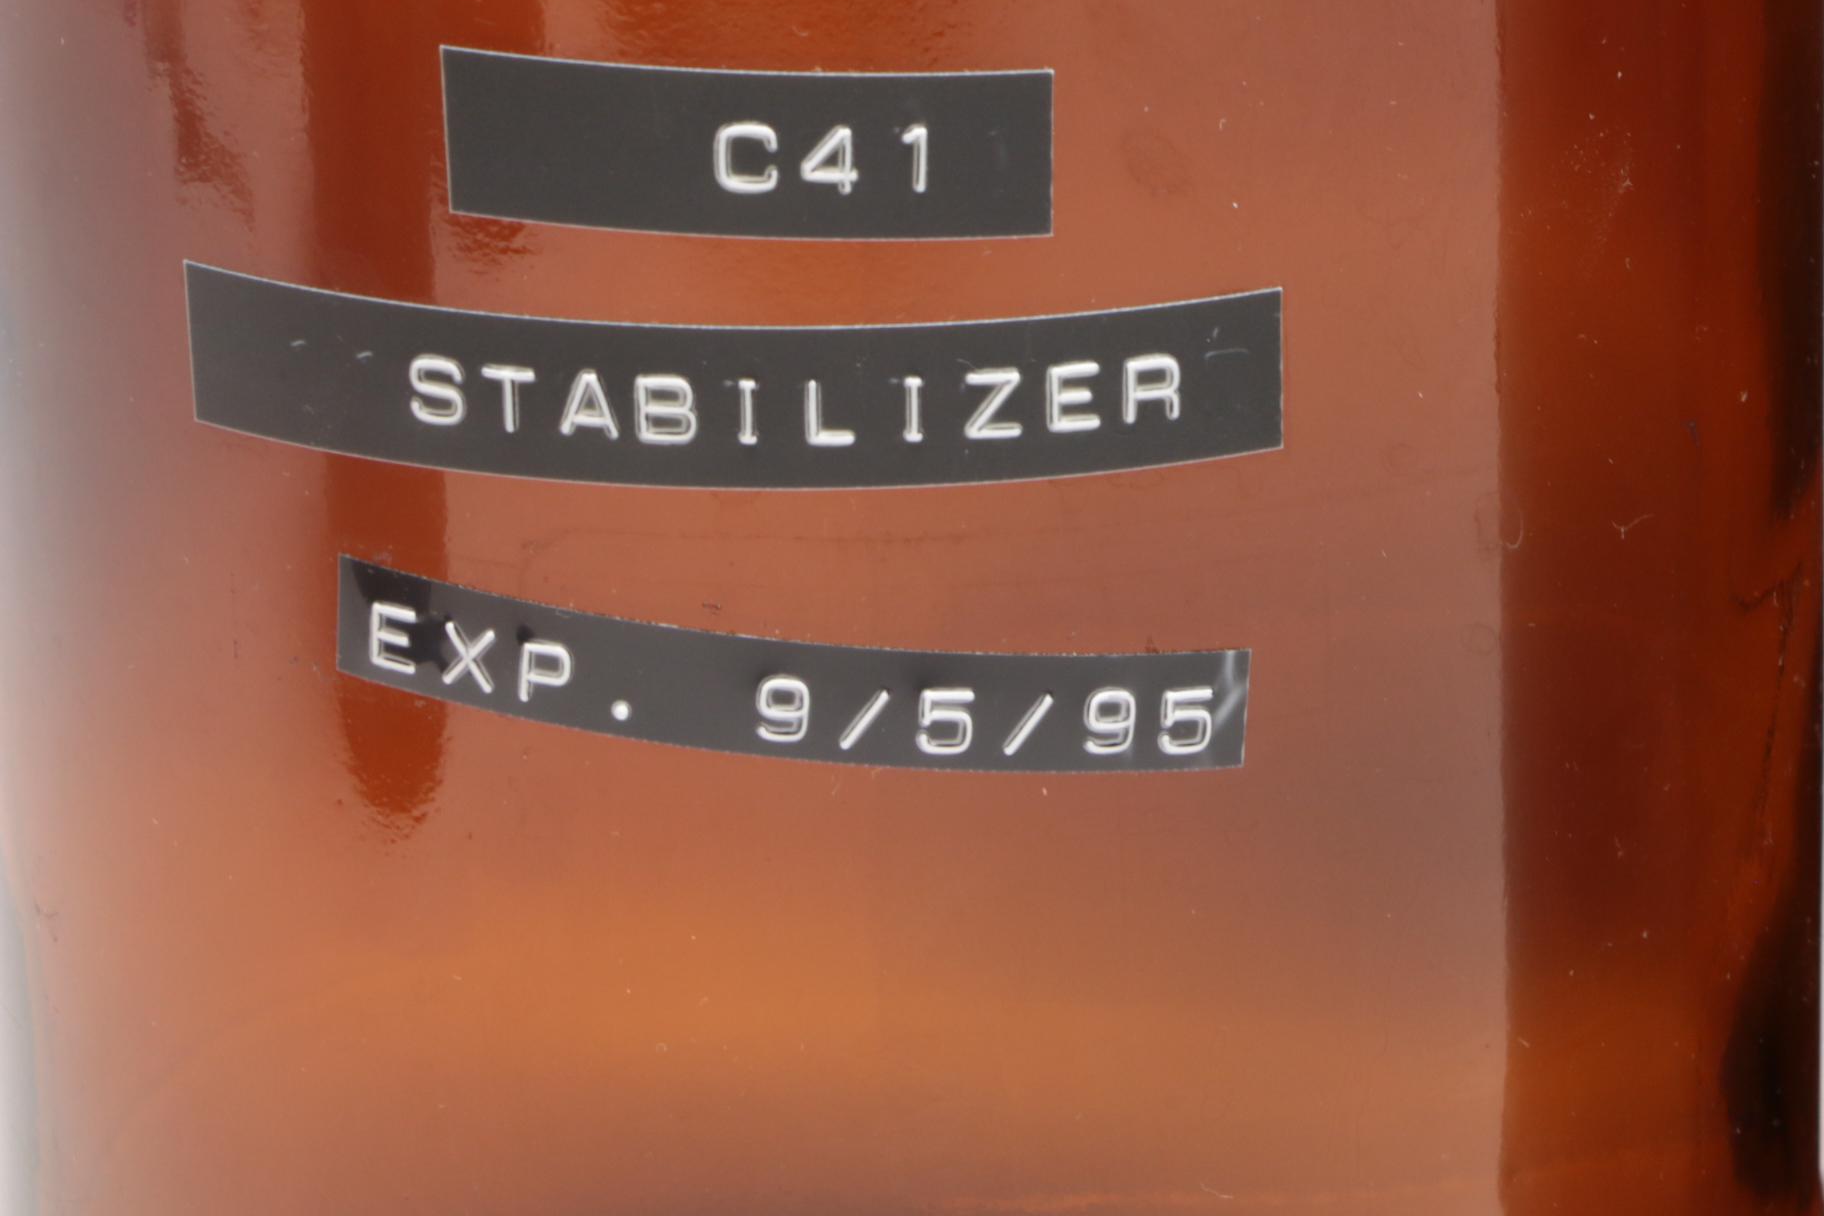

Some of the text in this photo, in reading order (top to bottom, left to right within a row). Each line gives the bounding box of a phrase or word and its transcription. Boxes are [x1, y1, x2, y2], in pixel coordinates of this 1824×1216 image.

[711, 122, 931, 196] C41
[407, 352, 1183, 448] STABILIZER
[366, 601, 1216, 758] EXP. 9/5/95
